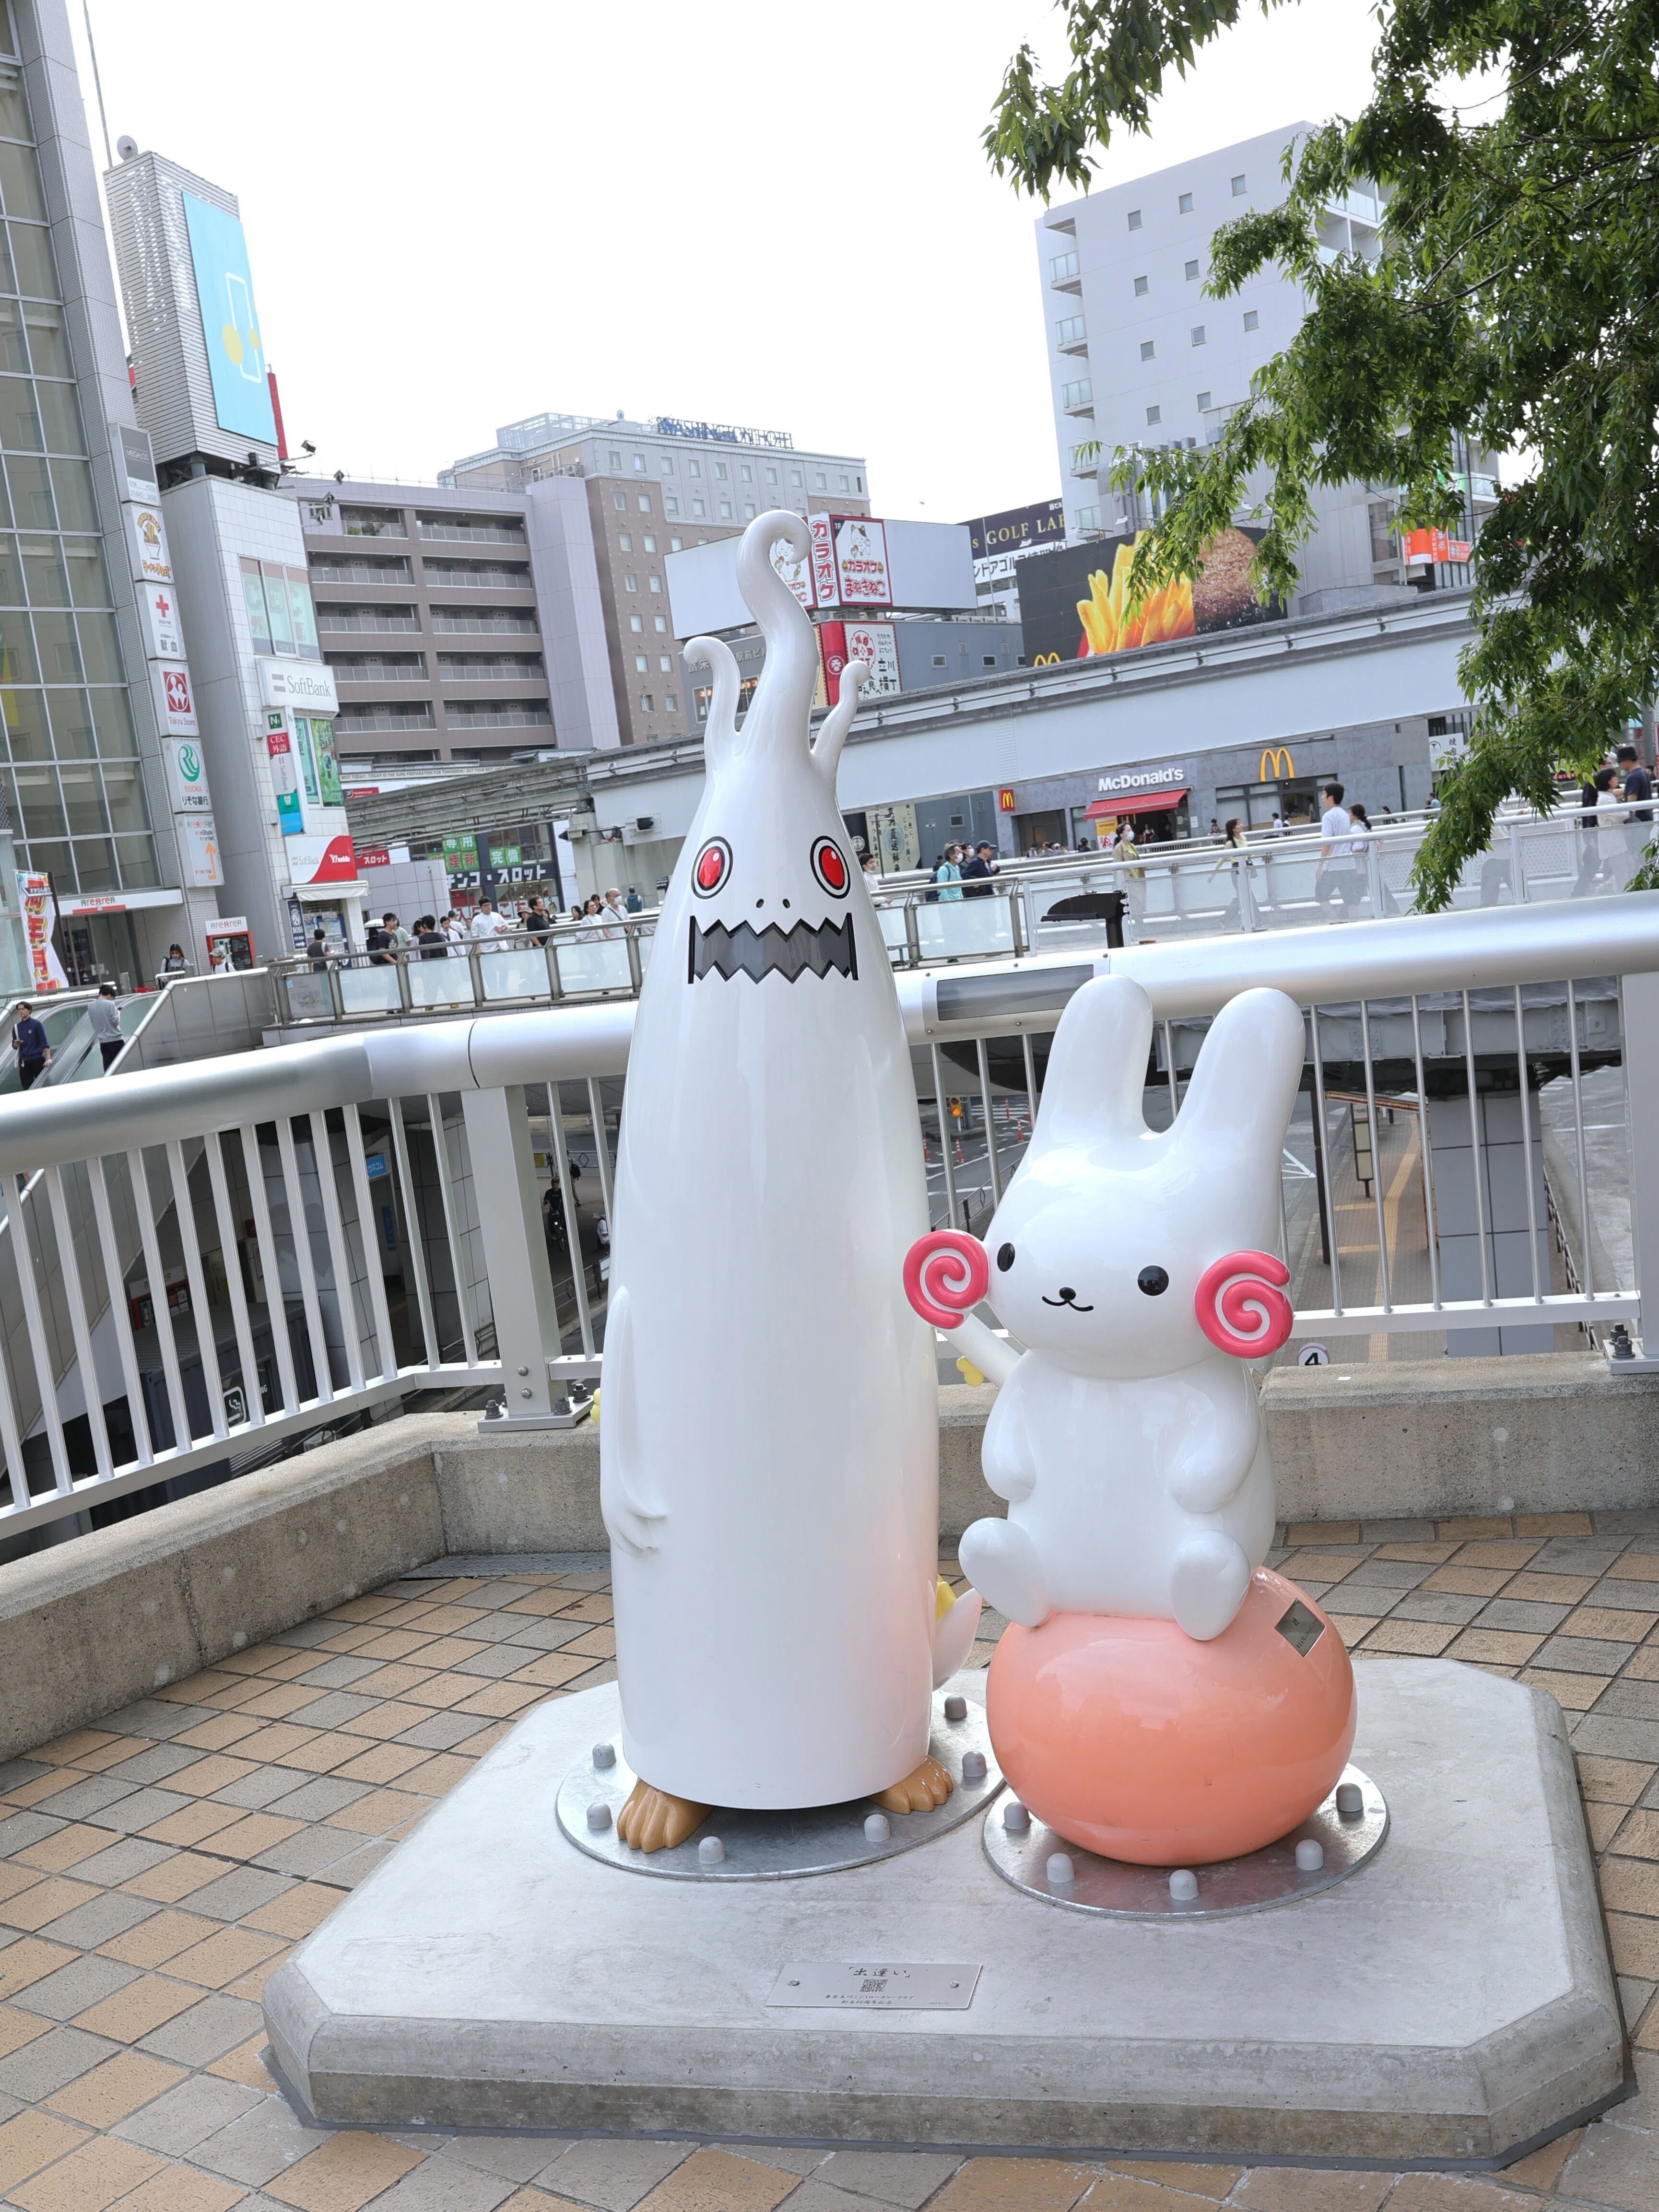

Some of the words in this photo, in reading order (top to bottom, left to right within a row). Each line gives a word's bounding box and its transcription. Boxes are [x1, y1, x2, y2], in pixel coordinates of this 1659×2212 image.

[986, 523, 1029, 545] GOLF
[812, 521, 835, 601] カラオケ
[847, 560, 878, 573] カラオケ
[845, 577, 886, 598] まねきねこ
[734, 647, 766, 662] 駅前ビル
[878, 658, 895, 672] 立川
[287, 675, 331, 697] SoftBank
[168, 716, 183, 726] Tokyu
[270, 735, 285, 743] CEC
[280, 765, 289, 791] SoftBank
[1098, 767, 1184, 792] McDonald's
[182, 796, 209, 806] りそな銀行
[299, 855, 320, 865] SoftBank
[364, 855, 387, 864] スロット
[492, 849, 519, 864] 完備
[1305, 1352, 1322, 1366] 4
